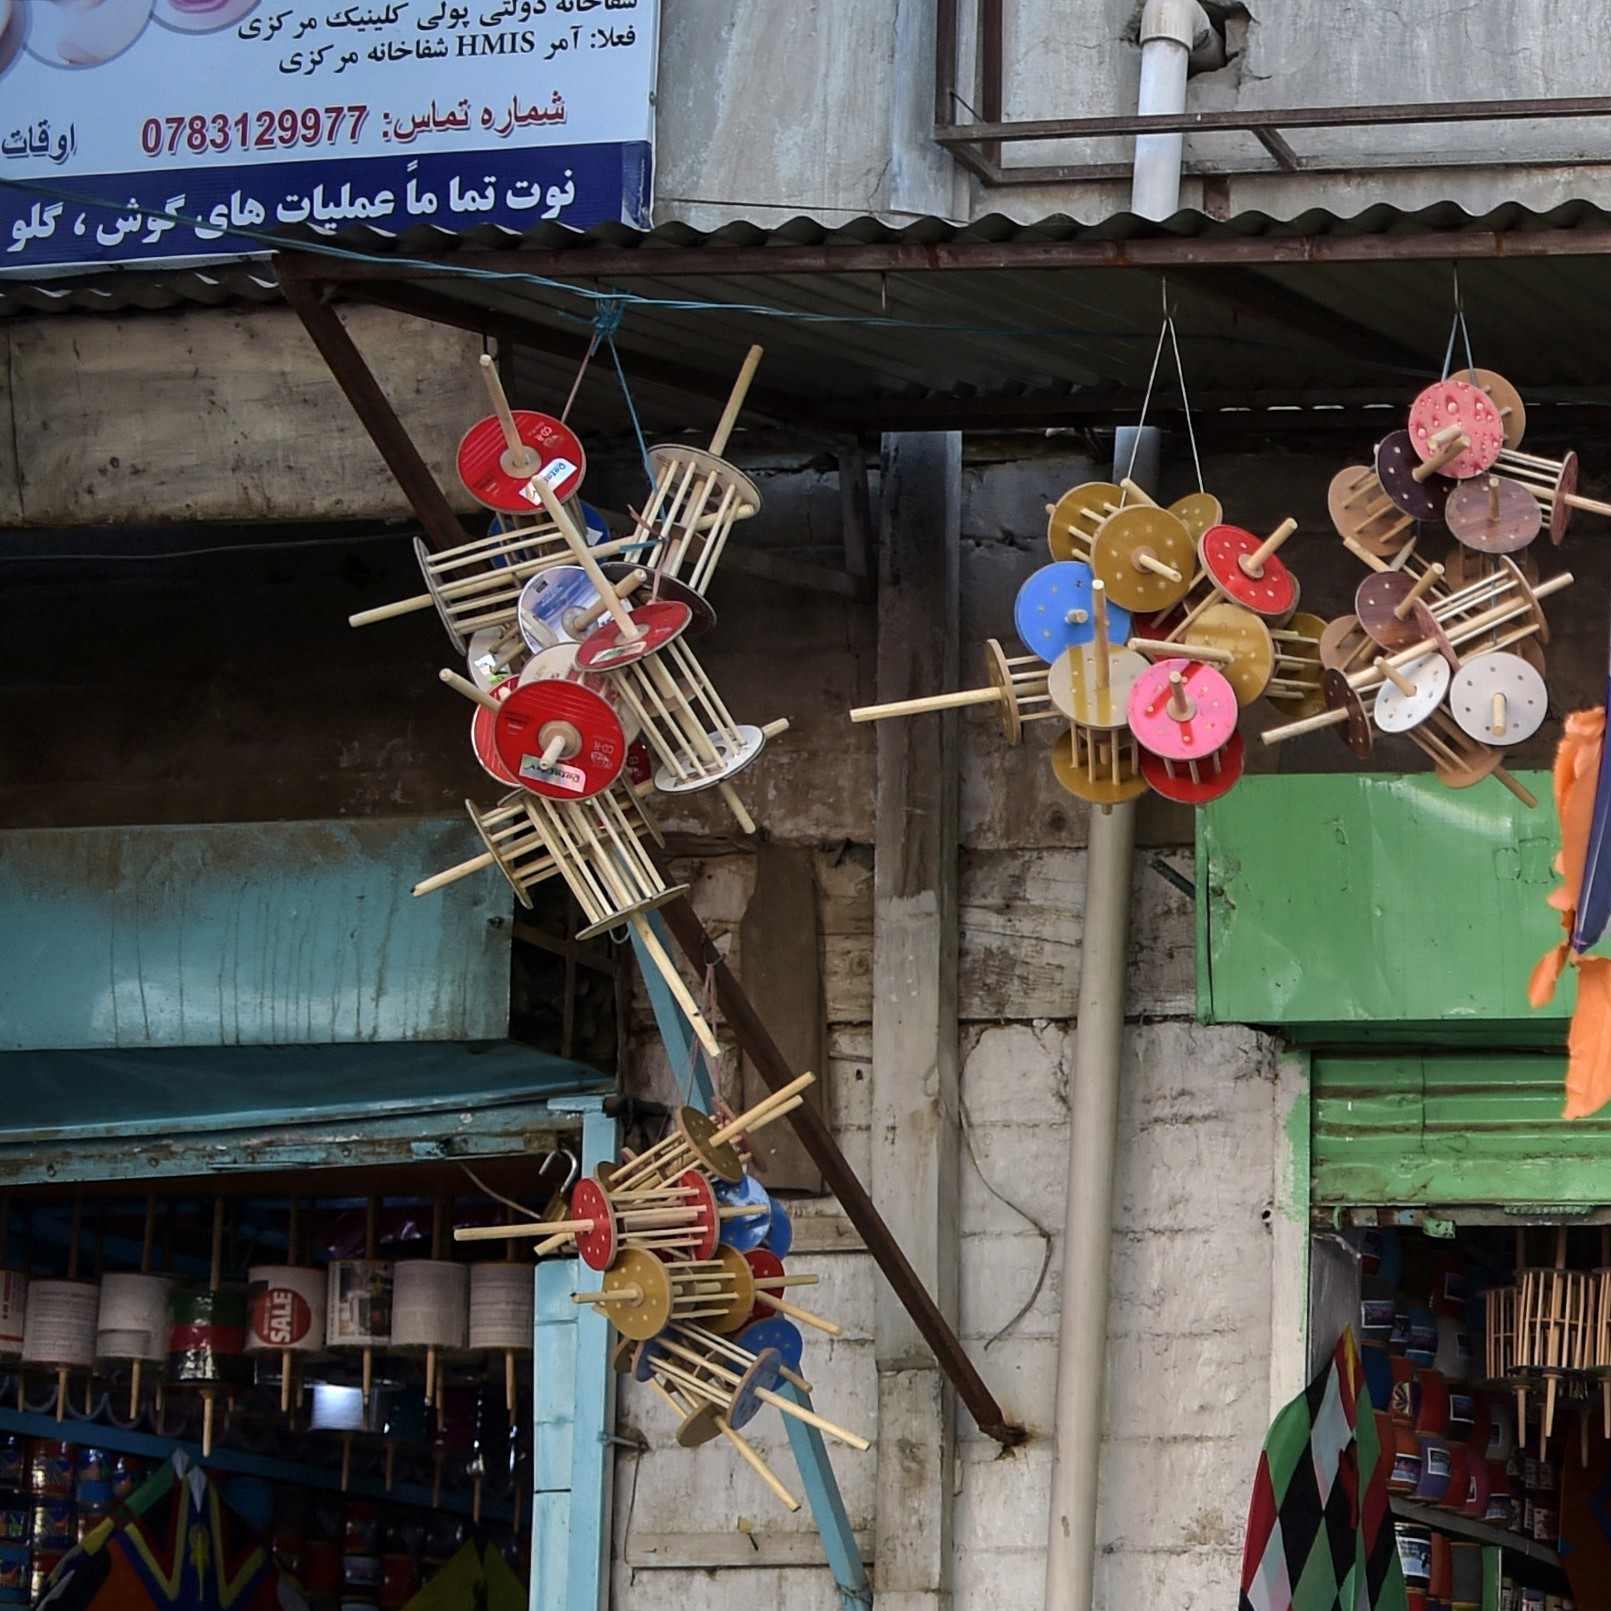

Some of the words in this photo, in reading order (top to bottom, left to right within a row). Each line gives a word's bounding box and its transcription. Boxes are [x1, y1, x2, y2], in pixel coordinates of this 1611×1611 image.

[416, 1, 468, 30] پولی
[367, 35, 449, 63] شفاخانه
[456, 30, 536, 57] HMIS
[543, 25, 584, 59] آمر
[1, 119, 77, 164] اوقات
[142, 104, 369, 157] 0783129977
[194, 190, 266, 240] های
[276, 182, 396, 231] عملیات
[505, 169, 576, 219] نوت
[6, 201, 65, 253] گلو
[96, 193, 186, 247] گوش
[269, 1289, 294, 1343] SALE
